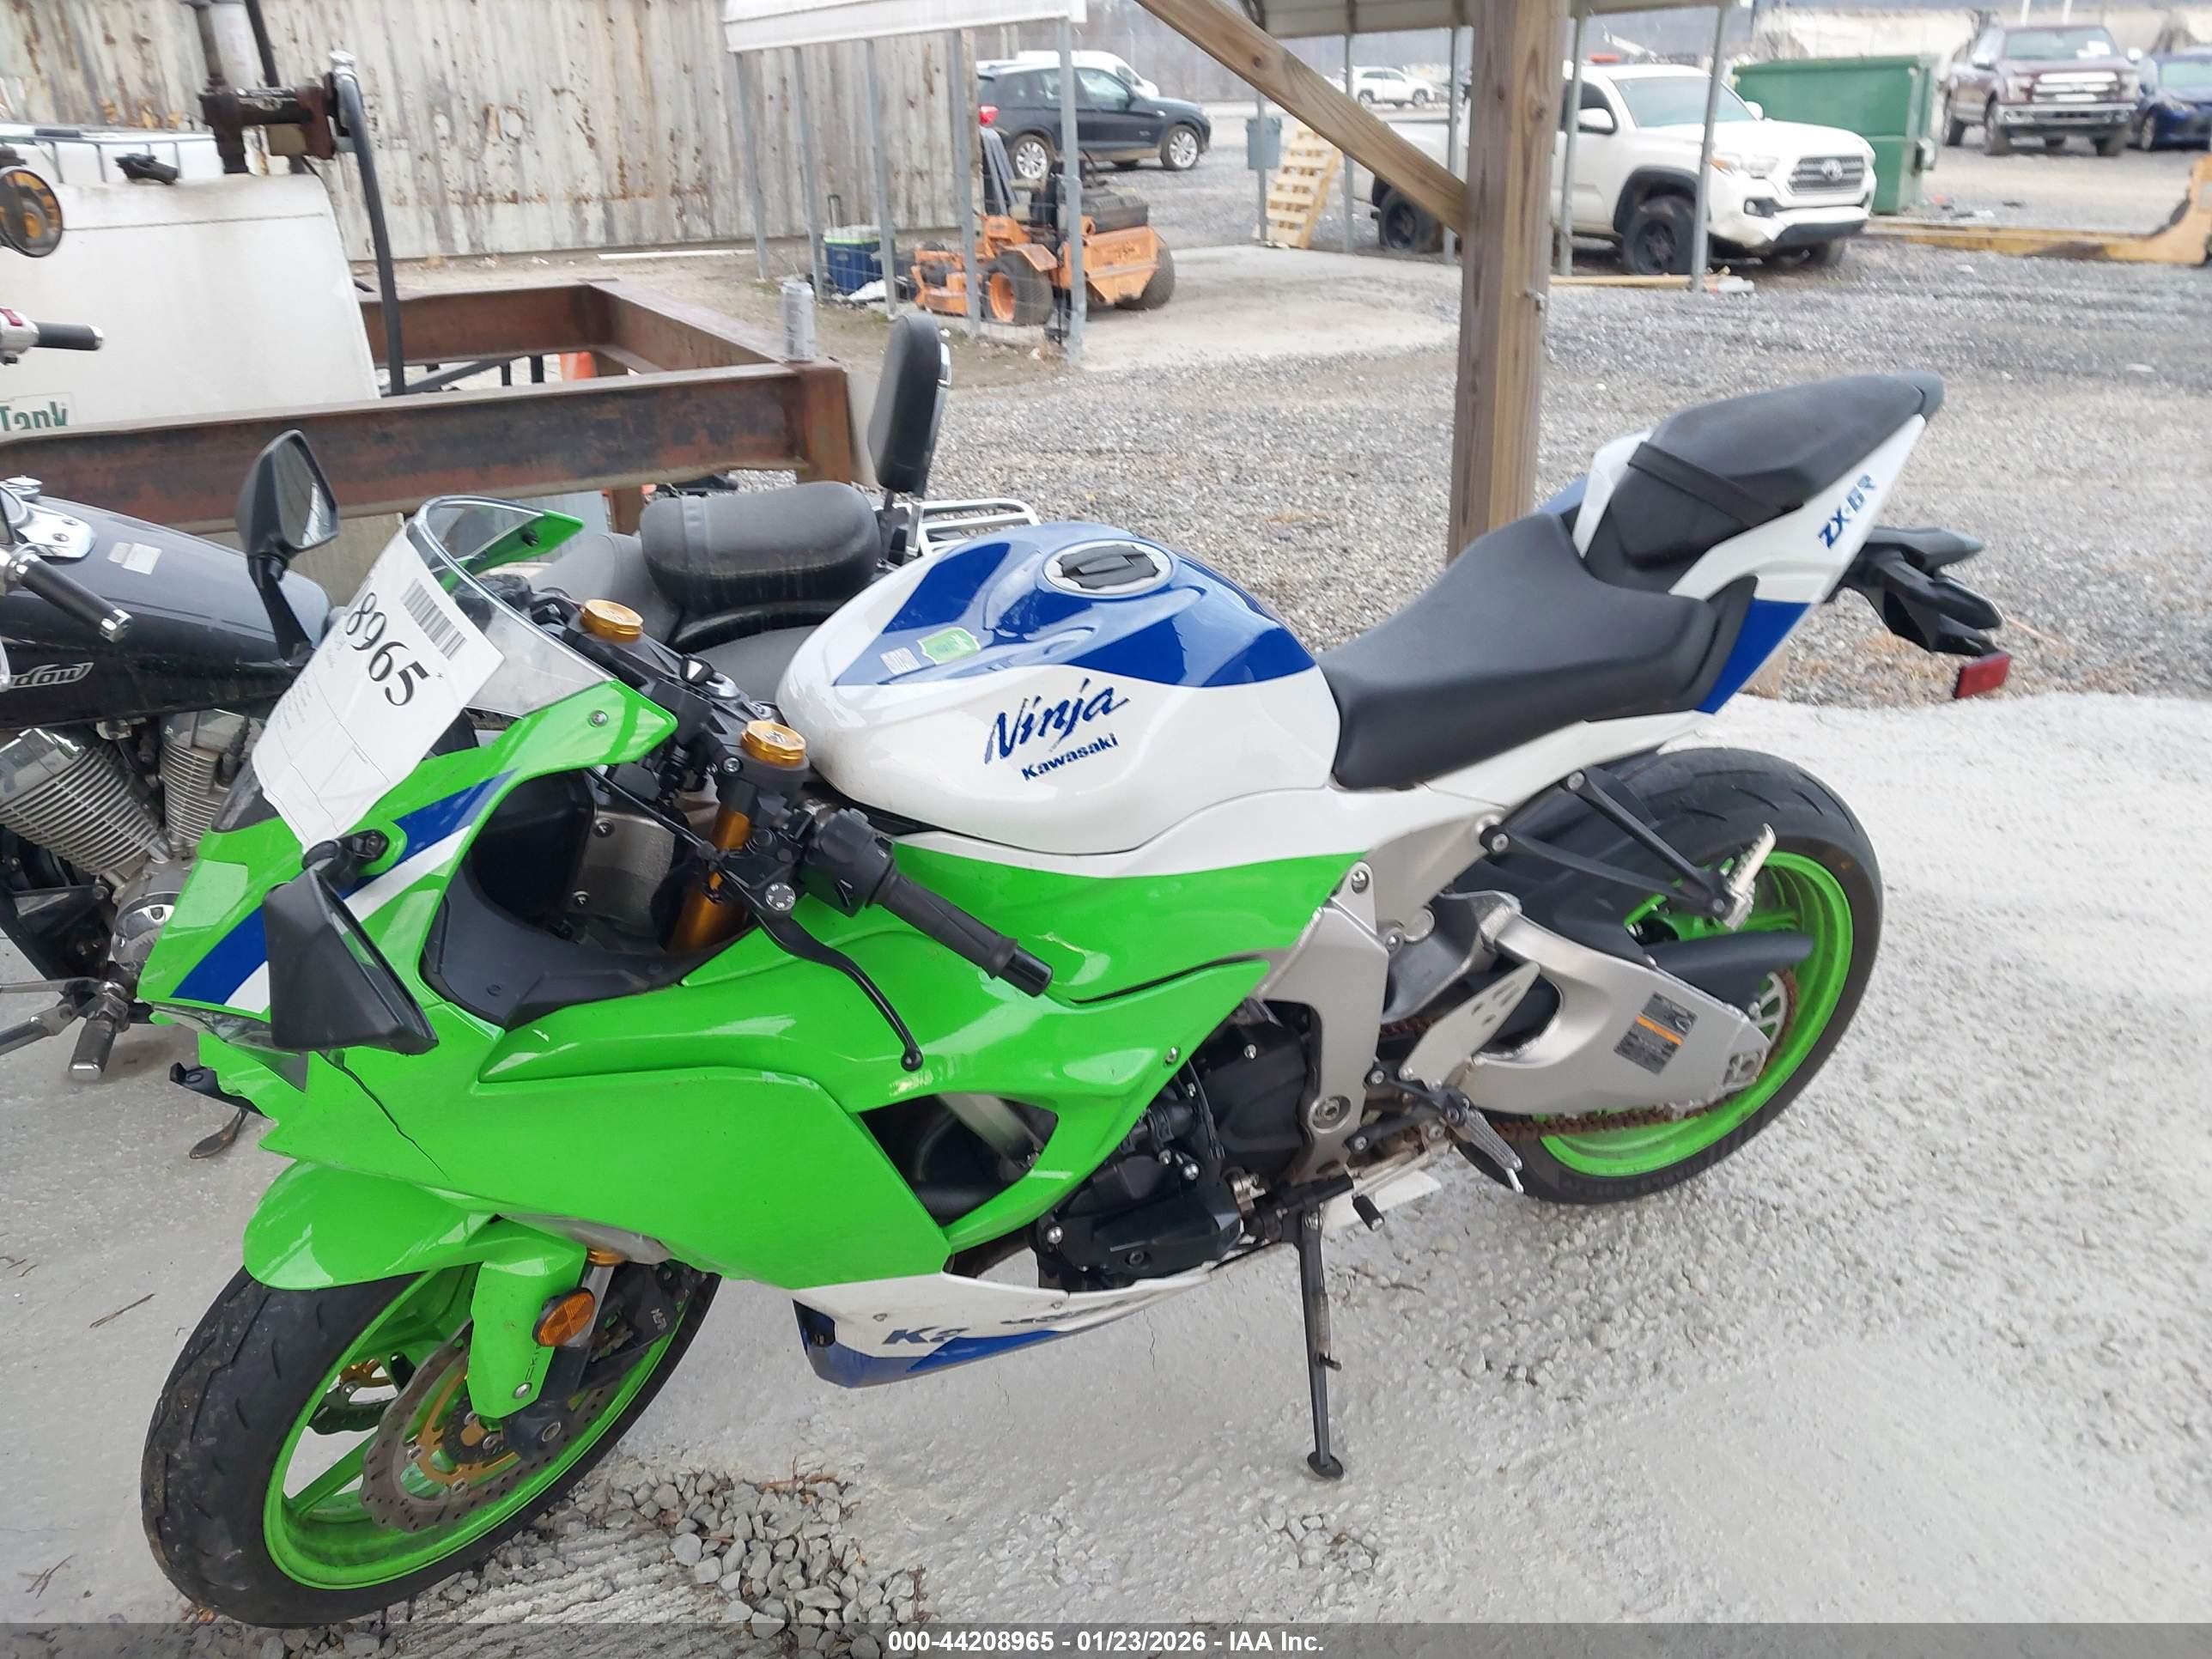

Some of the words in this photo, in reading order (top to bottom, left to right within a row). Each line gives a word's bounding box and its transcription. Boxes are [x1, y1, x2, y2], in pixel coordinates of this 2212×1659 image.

[346, 592, 431, 707] 8965
[984, 678, 1131, 765] Ninja
[1021, 732, 1119, 782] Kawasaki
